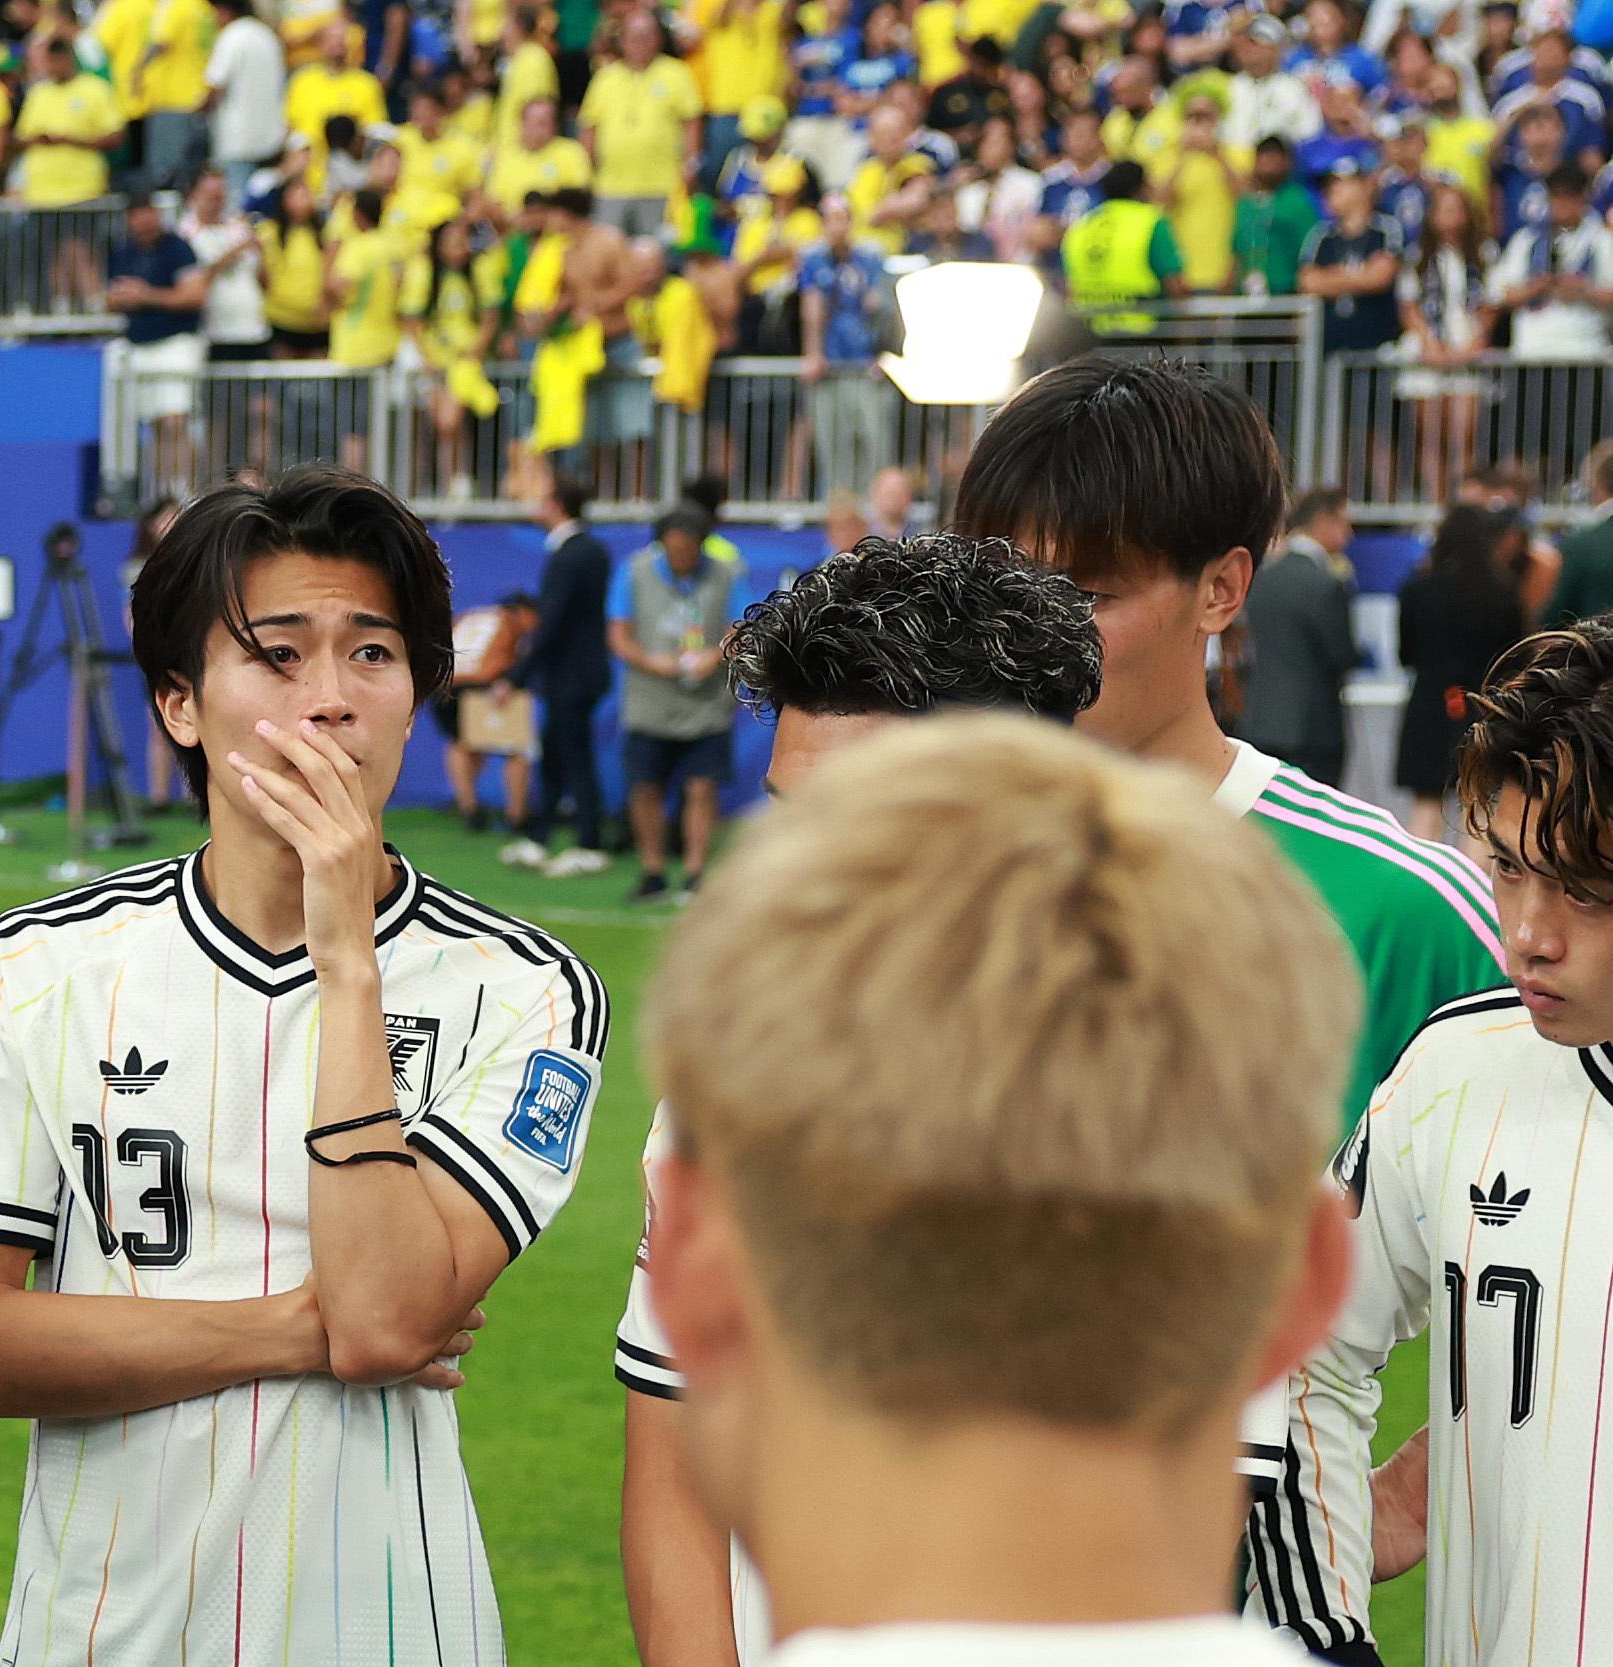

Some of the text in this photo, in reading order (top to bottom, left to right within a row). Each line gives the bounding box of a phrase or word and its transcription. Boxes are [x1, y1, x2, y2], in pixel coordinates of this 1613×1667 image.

[385, 1016, 417, 1028] PAN
[72, 1123, 193, 1271] 13
[1444, 1260, 1544, 1430] 17
